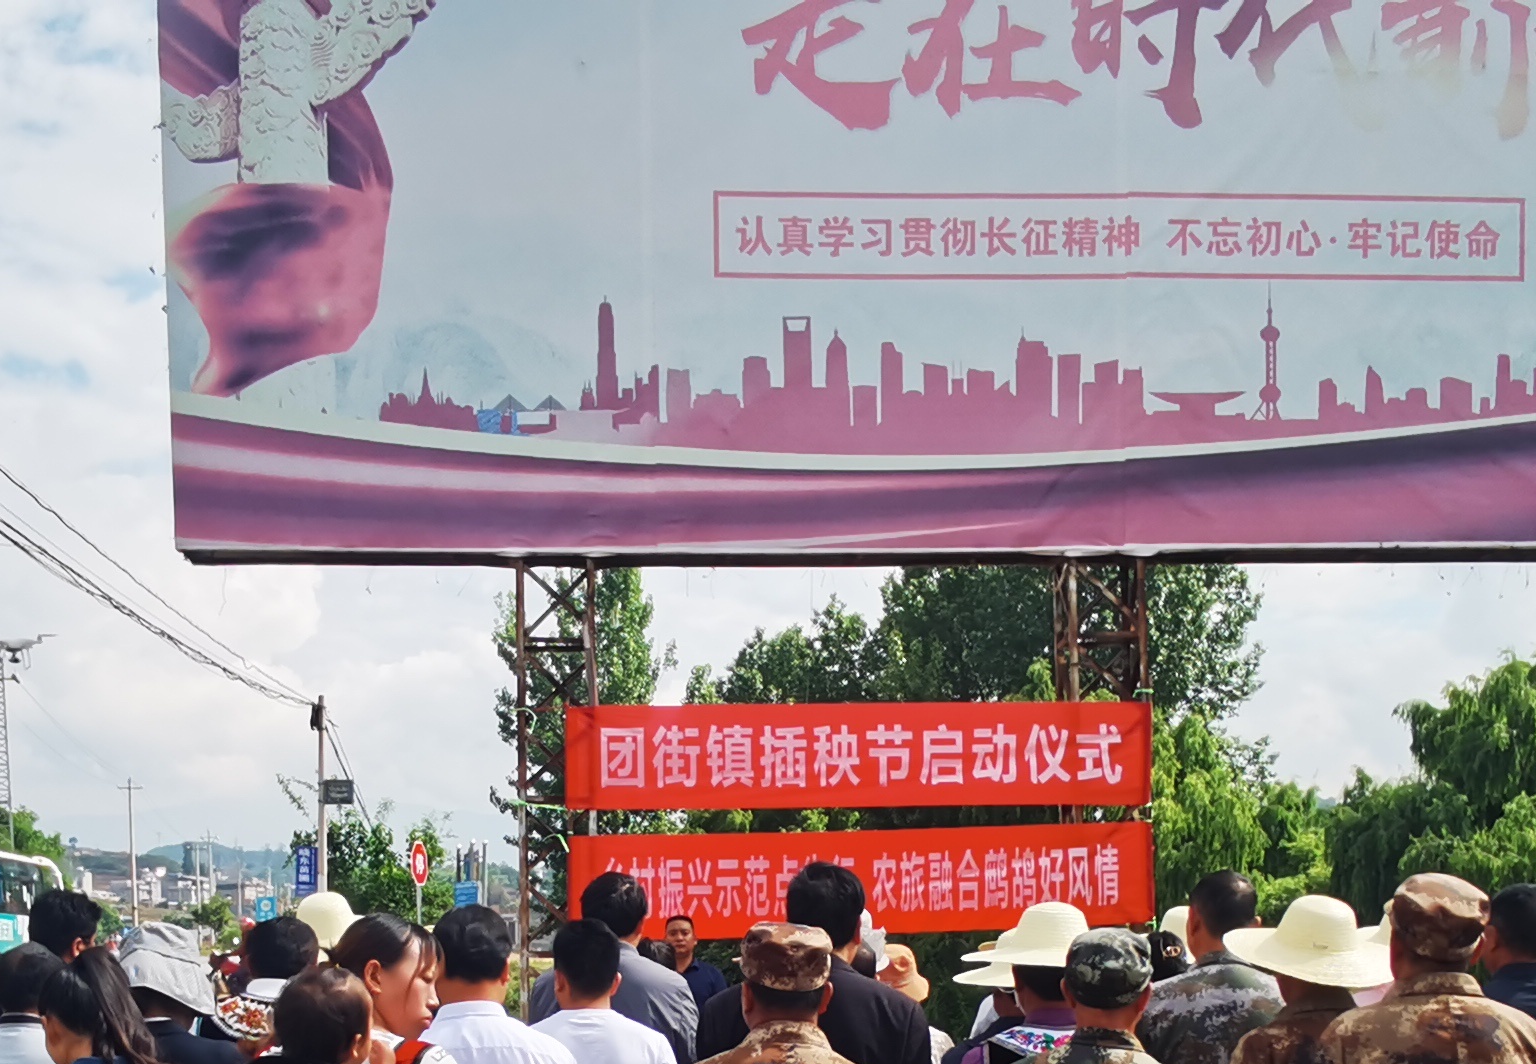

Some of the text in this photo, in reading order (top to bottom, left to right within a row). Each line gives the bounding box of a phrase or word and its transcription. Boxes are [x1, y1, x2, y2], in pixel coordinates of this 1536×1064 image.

[735, 215, 1502, 260] 认真学习贯彻长征精神 不忘初心·牢记使命
[599, 724, 1123, 789] 团街镇插秧节启动仪式
[603, 852, 856, 919] 村振兴示范点
